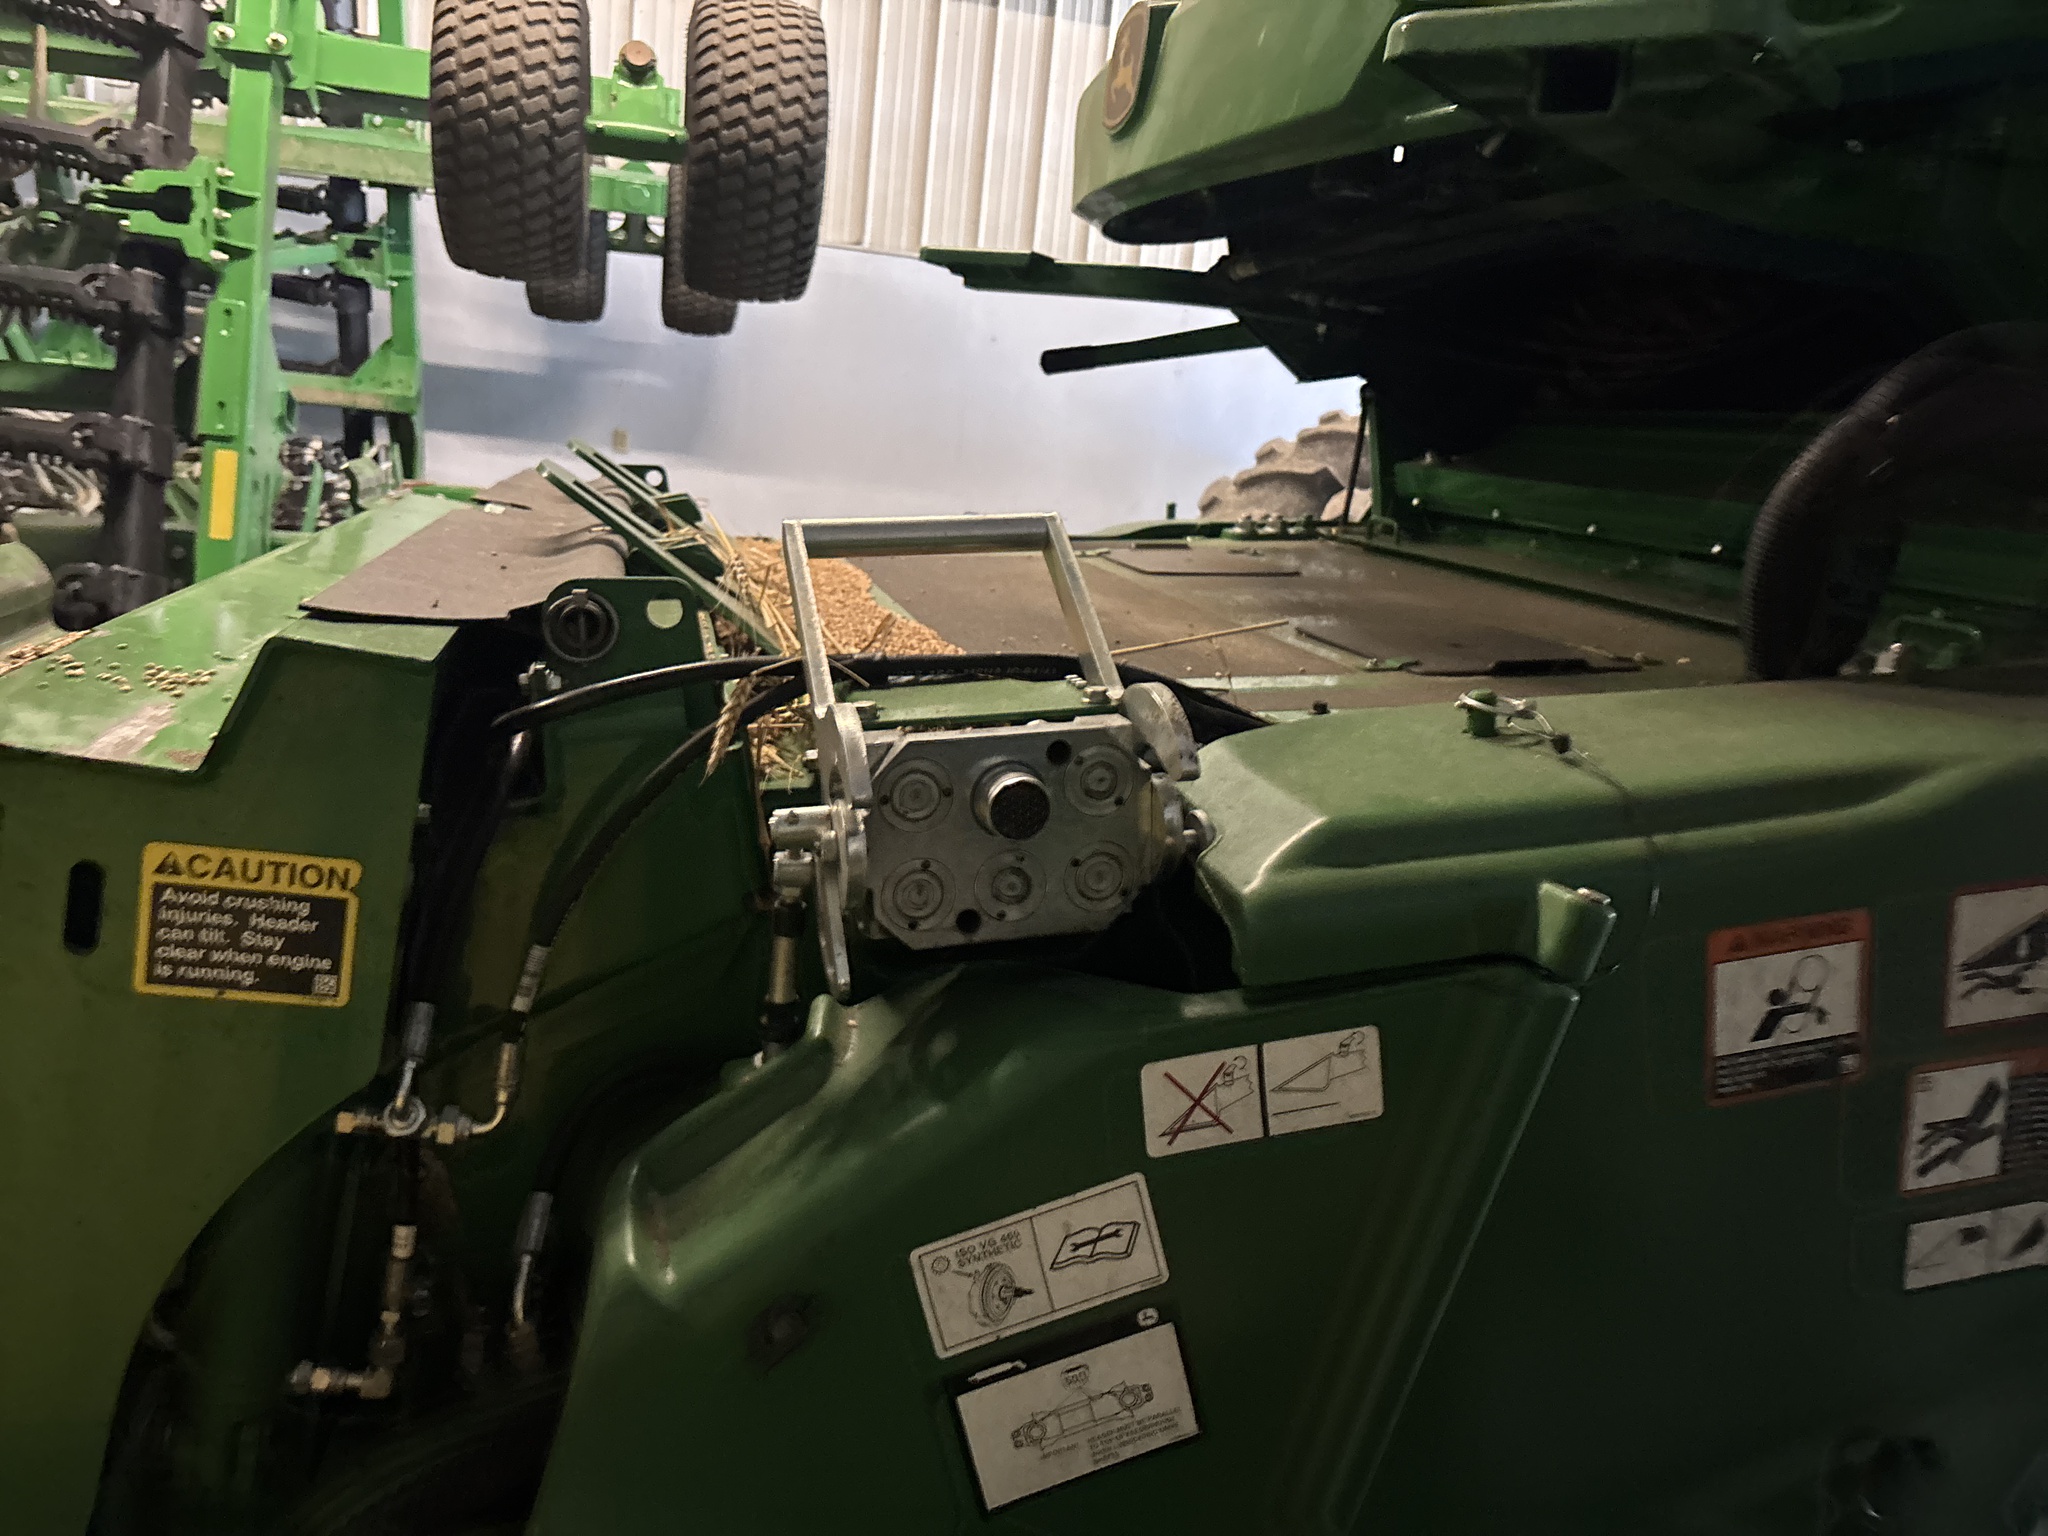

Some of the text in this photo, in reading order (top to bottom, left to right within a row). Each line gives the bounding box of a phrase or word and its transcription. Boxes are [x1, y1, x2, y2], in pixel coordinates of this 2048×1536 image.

[186, 853, 351, 891] CAUTION
[159, 887, 311, 919] Avoid crushing
[248, 912, 319, 934] Header
[155, 927, 195, 942] can
[240, 930, 286, 952] Stay
[154, 943, 333, 973] clear when engine
[153, 960, 260, 988] is running.
[957, 1239, 1023, 1269] SYNTHETIC
